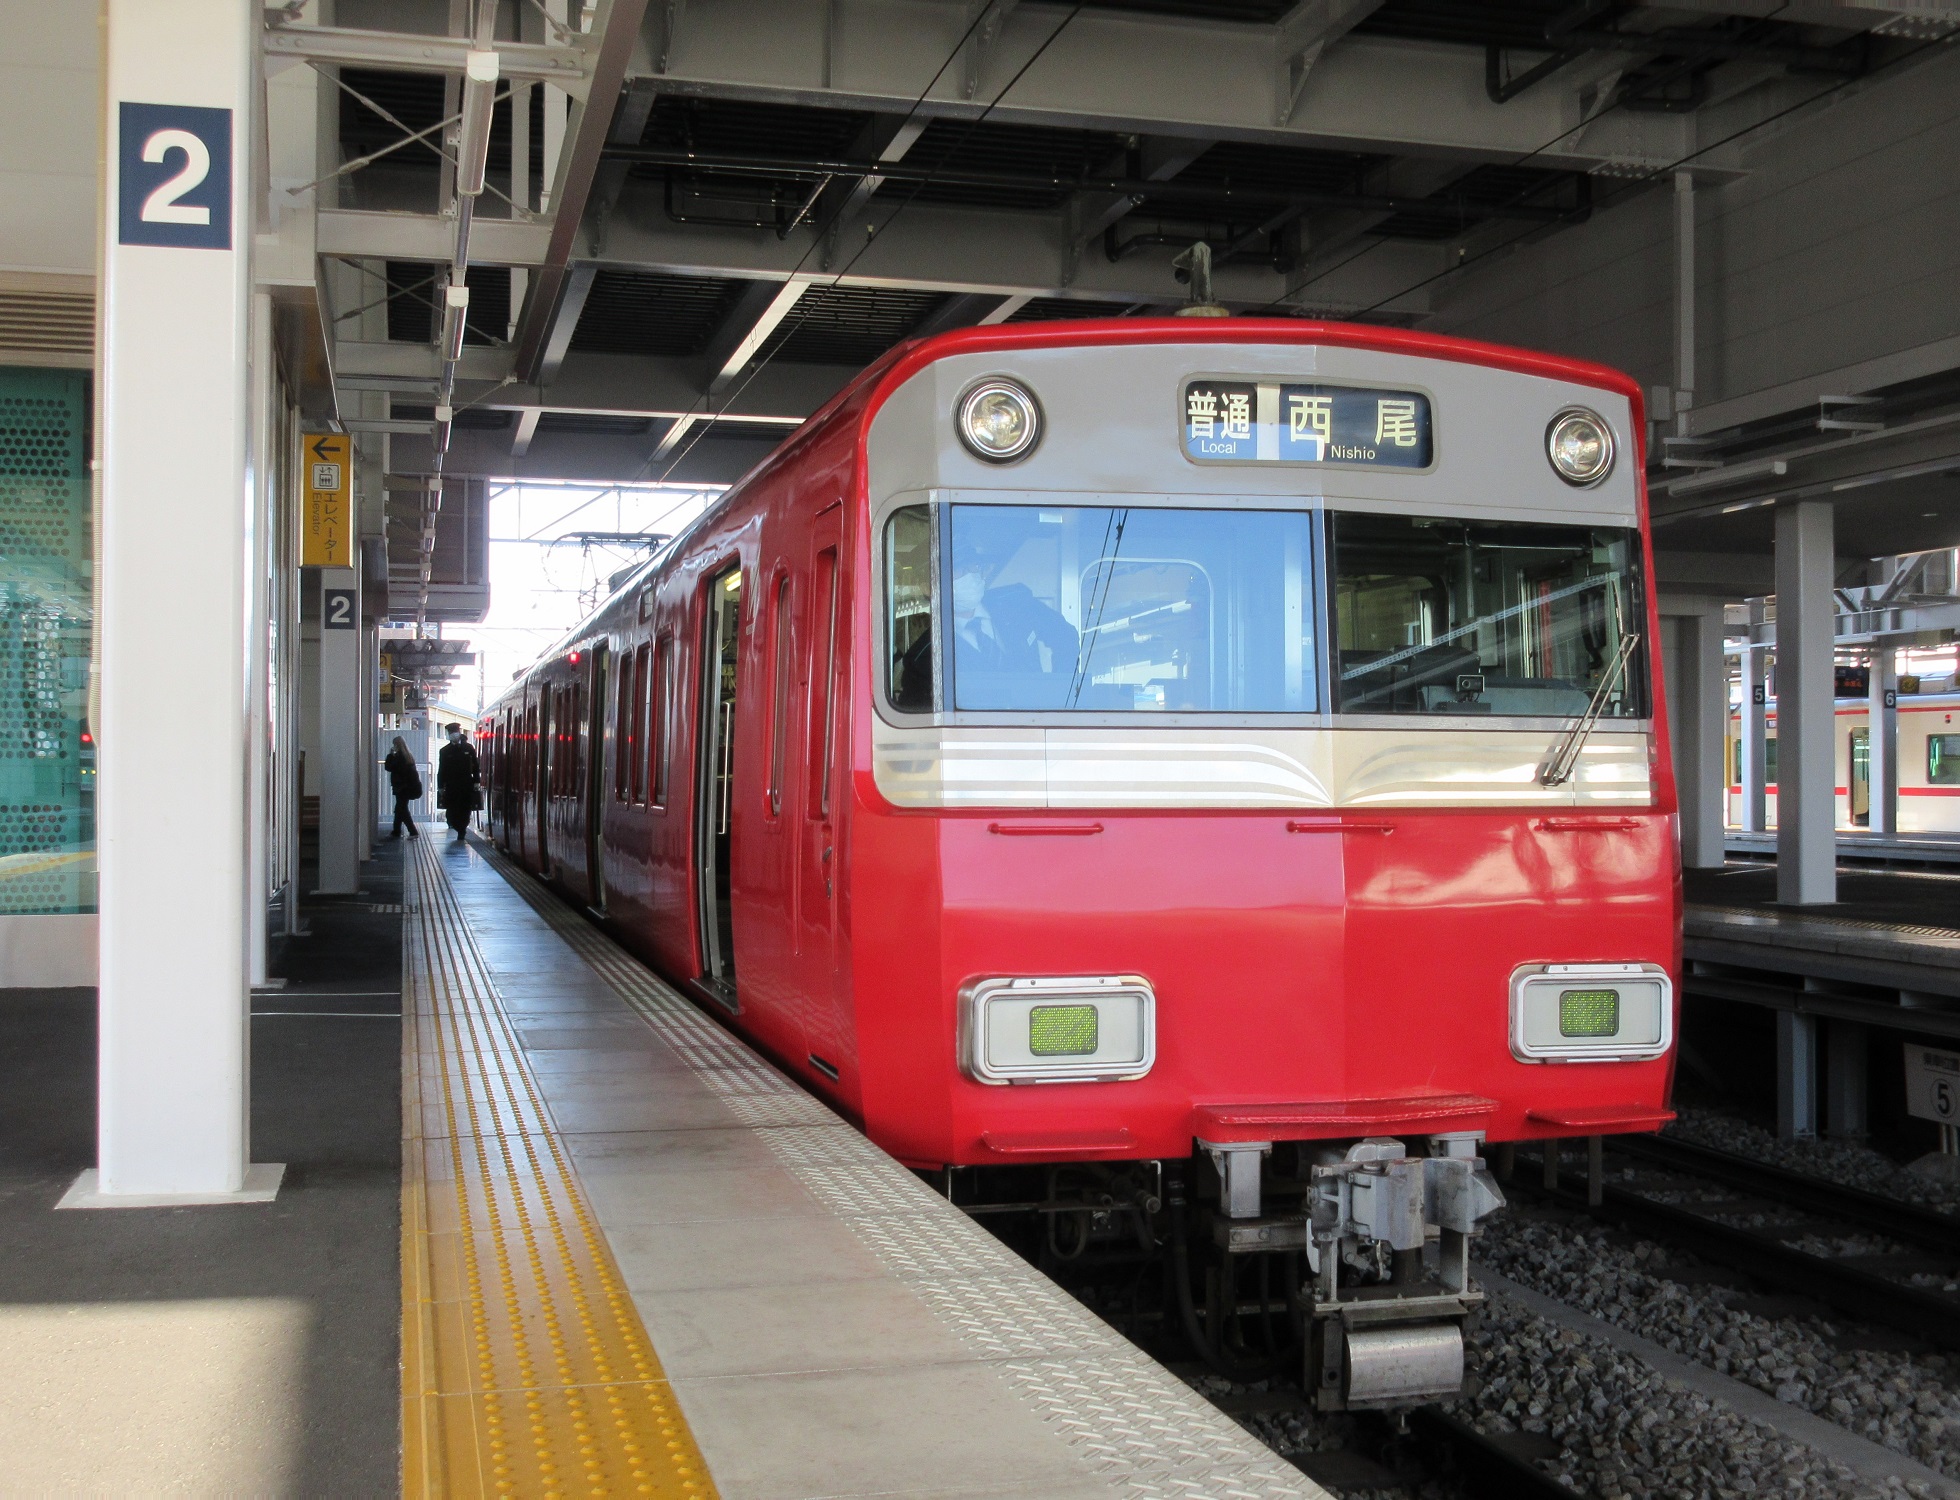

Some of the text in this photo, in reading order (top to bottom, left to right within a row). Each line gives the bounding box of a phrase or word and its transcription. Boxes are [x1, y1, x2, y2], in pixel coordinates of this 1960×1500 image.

[141, 129, 211, 225] 2
[1187, 391, 1250, 440] 普通
[1200, 440, 1237, 454] Local
[1331, 444, 1376, 460] Nishio
[312, 492, 322, 536] Elevator
[323, 493, 338, 562] エレベーター
[330, 596, 351, 624] 2
[1755, 688, 1763, 702] 5
[1885, 692, 1894, 706] 6
[1937, 1082, 1950, 1115] 5
